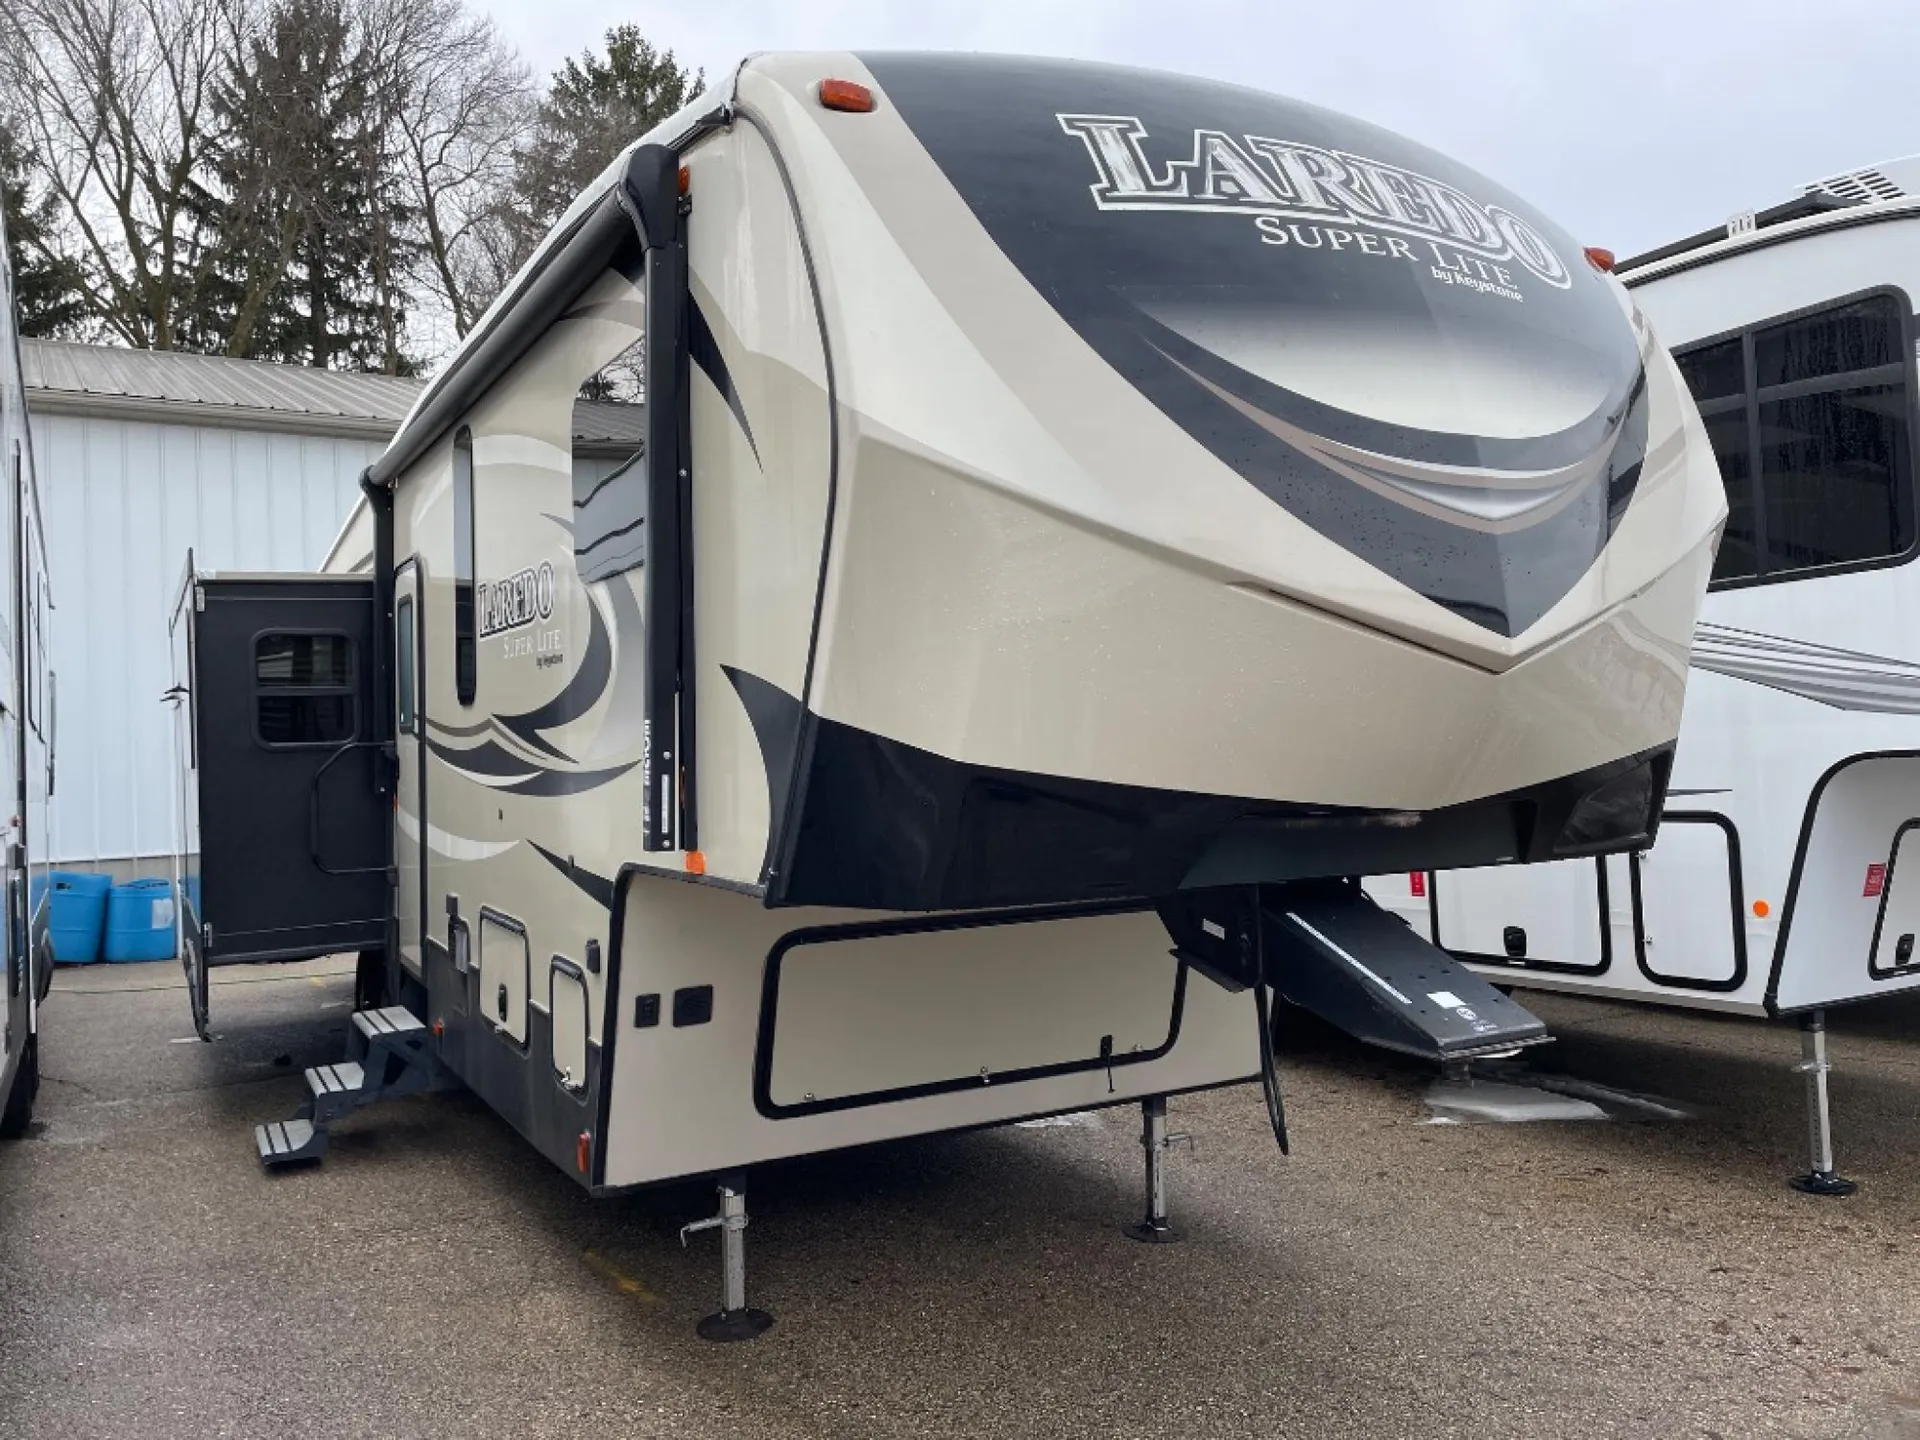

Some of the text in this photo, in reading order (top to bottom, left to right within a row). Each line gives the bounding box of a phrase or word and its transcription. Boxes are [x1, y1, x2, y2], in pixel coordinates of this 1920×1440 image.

[1056, 113, 1572, 290] LAREDO
[1254, 217, 1518, 289] SUPER LITE
[1431, 265, 1454, 286] by
[478, 559, 553, 641] LAREDO
[537, 628, 561, 652] LITE
